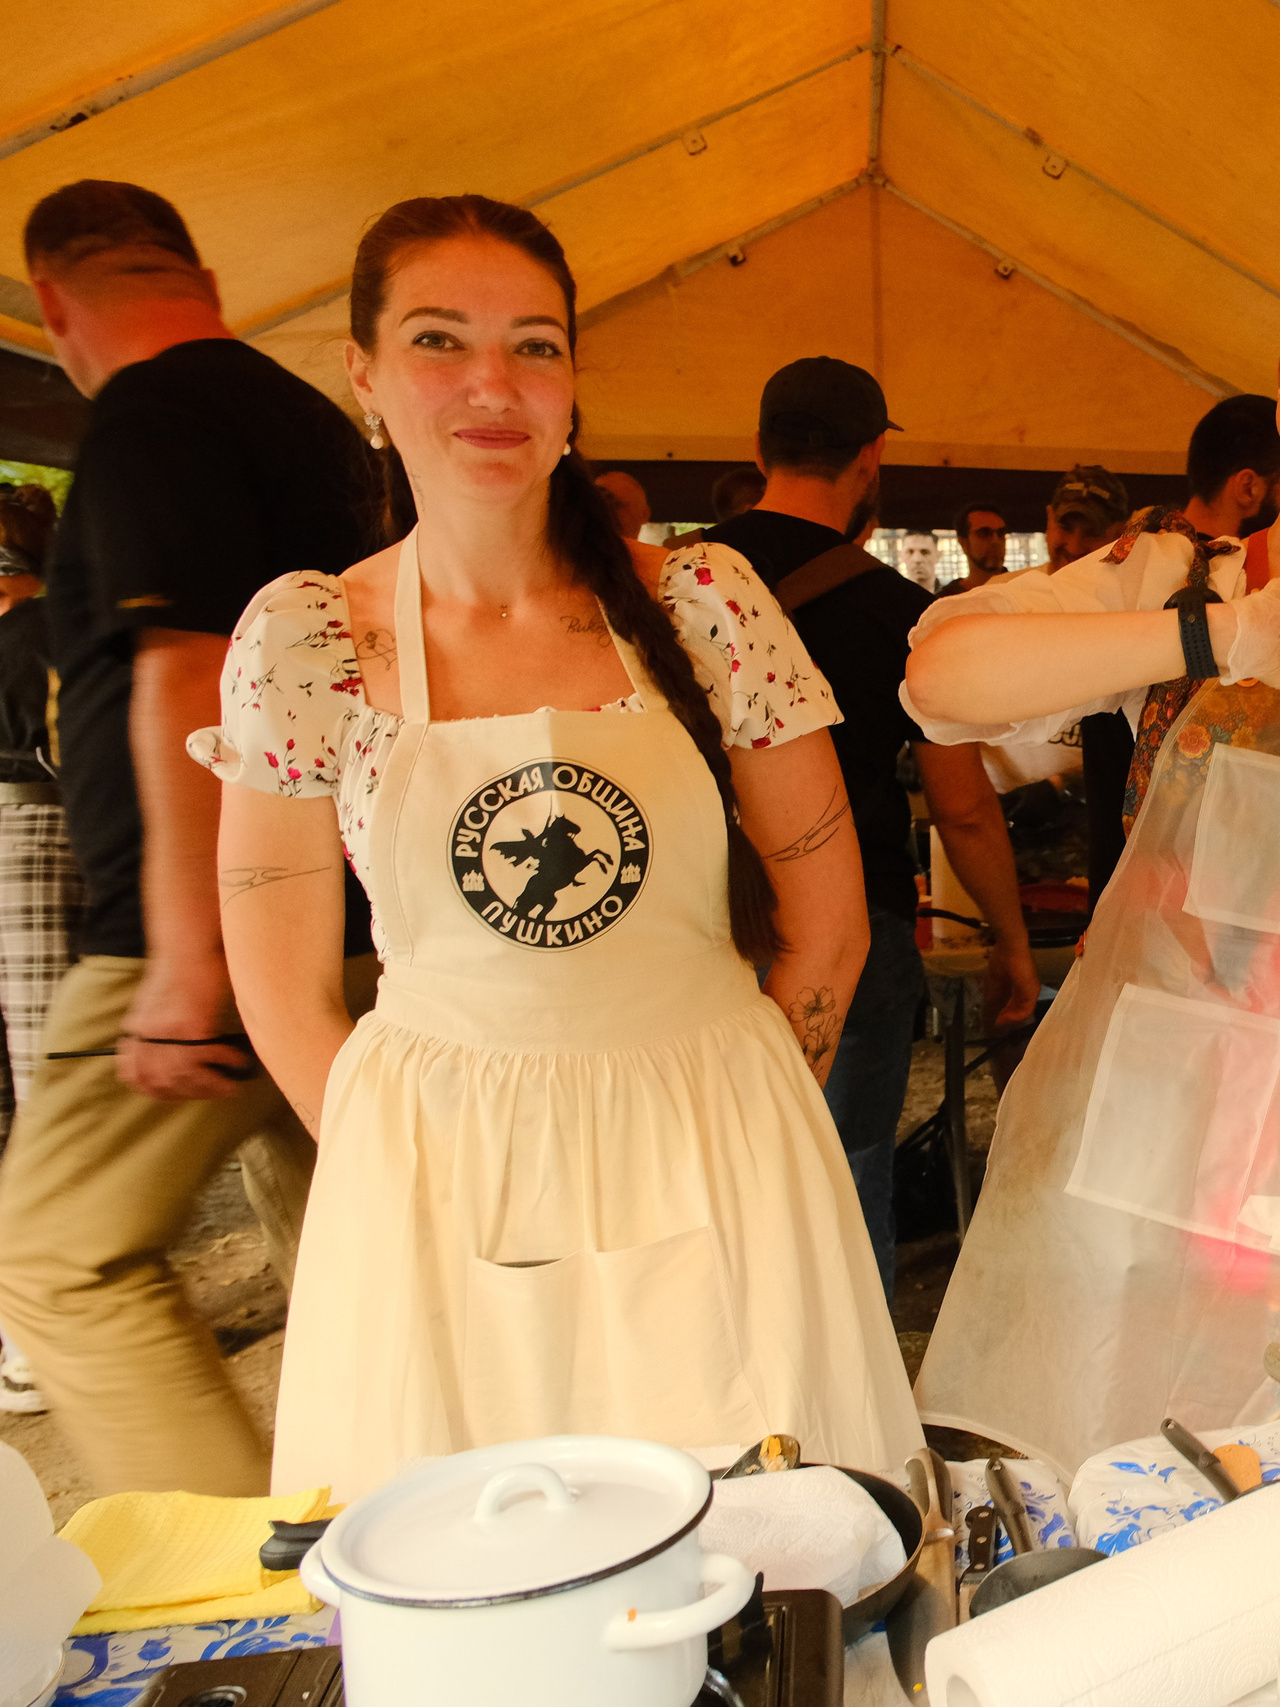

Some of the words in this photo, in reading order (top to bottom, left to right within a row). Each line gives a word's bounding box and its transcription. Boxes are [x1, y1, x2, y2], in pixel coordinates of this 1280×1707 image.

[455, 766, 545, 858] РУССКАЯ
[552, 765, 647, 852] ОБЩИНА
[480, 895, 623, 946] ПУШКИНО
